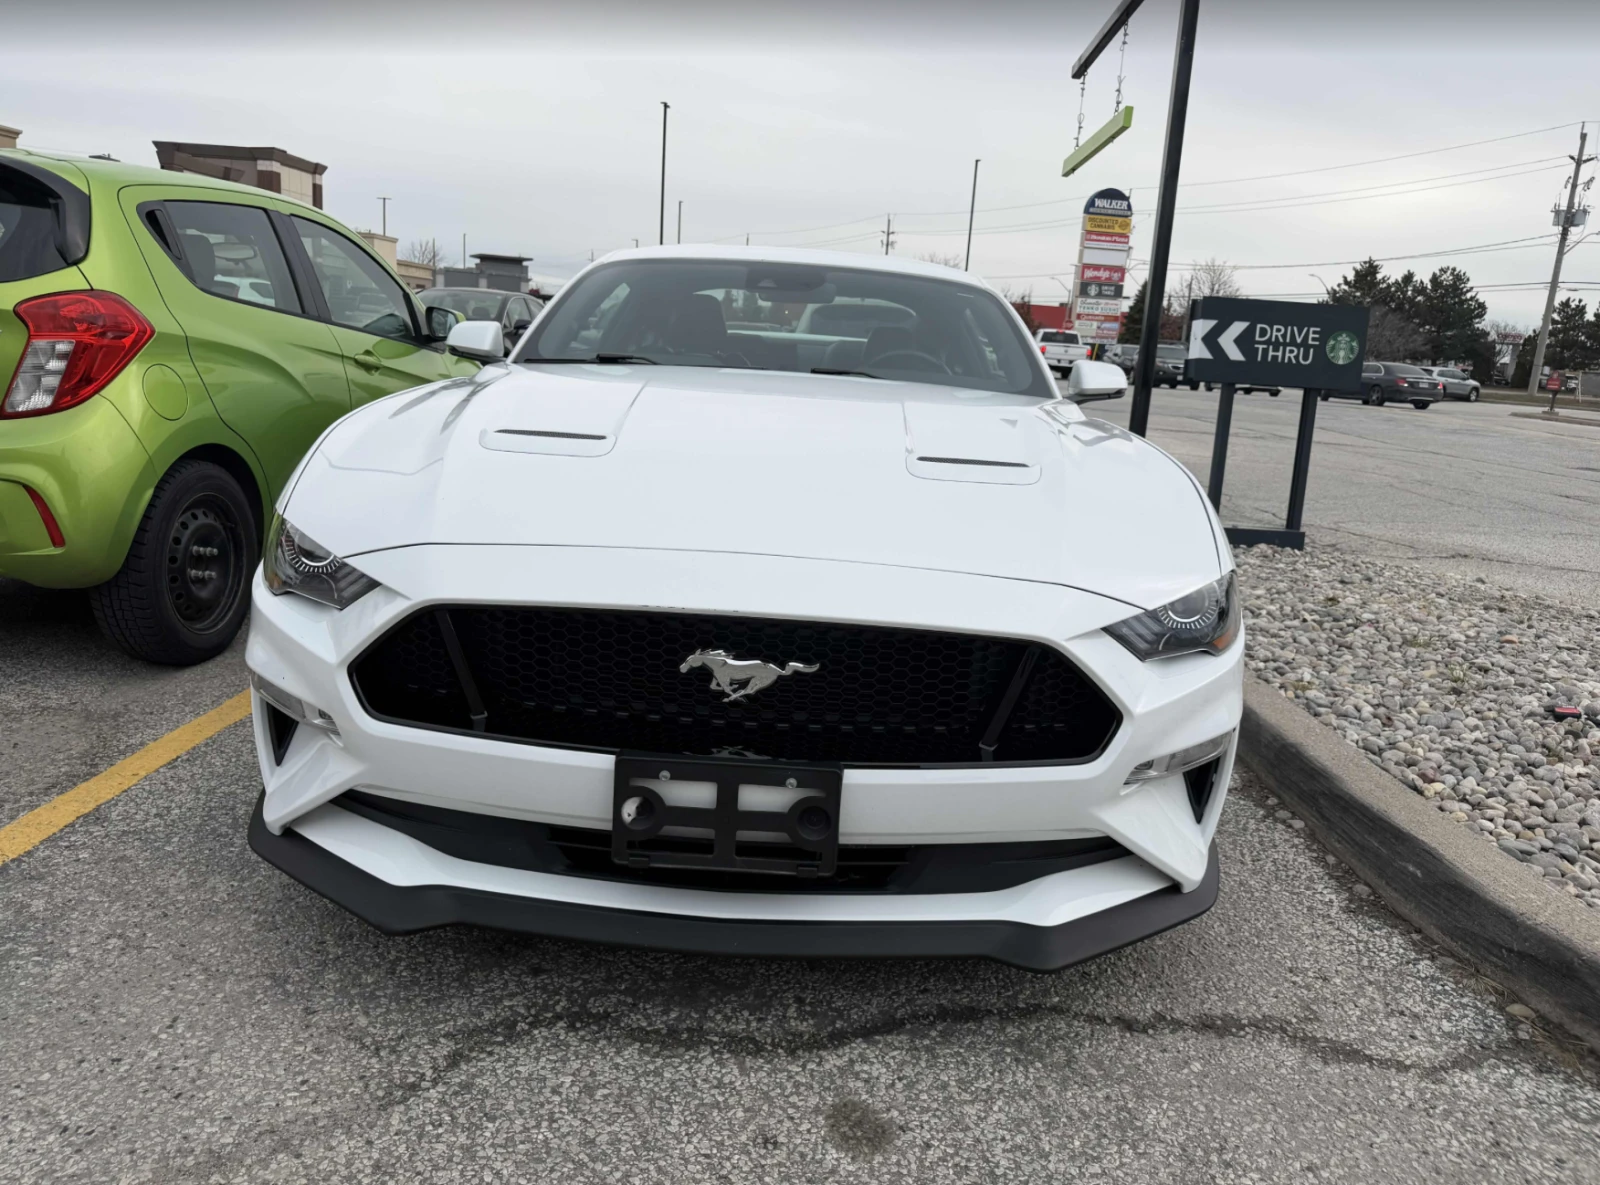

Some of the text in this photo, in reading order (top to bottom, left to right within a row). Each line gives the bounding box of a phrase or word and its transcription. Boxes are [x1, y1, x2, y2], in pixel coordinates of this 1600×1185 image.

[1095, 198, 1128, 209] WALKER
[1088, 216, 1119, 225] DISCOUNTED
[1090, 222, 1115, 230] CANNABIS
[1255, 323, 1321, 345] DRIVE
[1254, 344, 1314, 365] THRU
